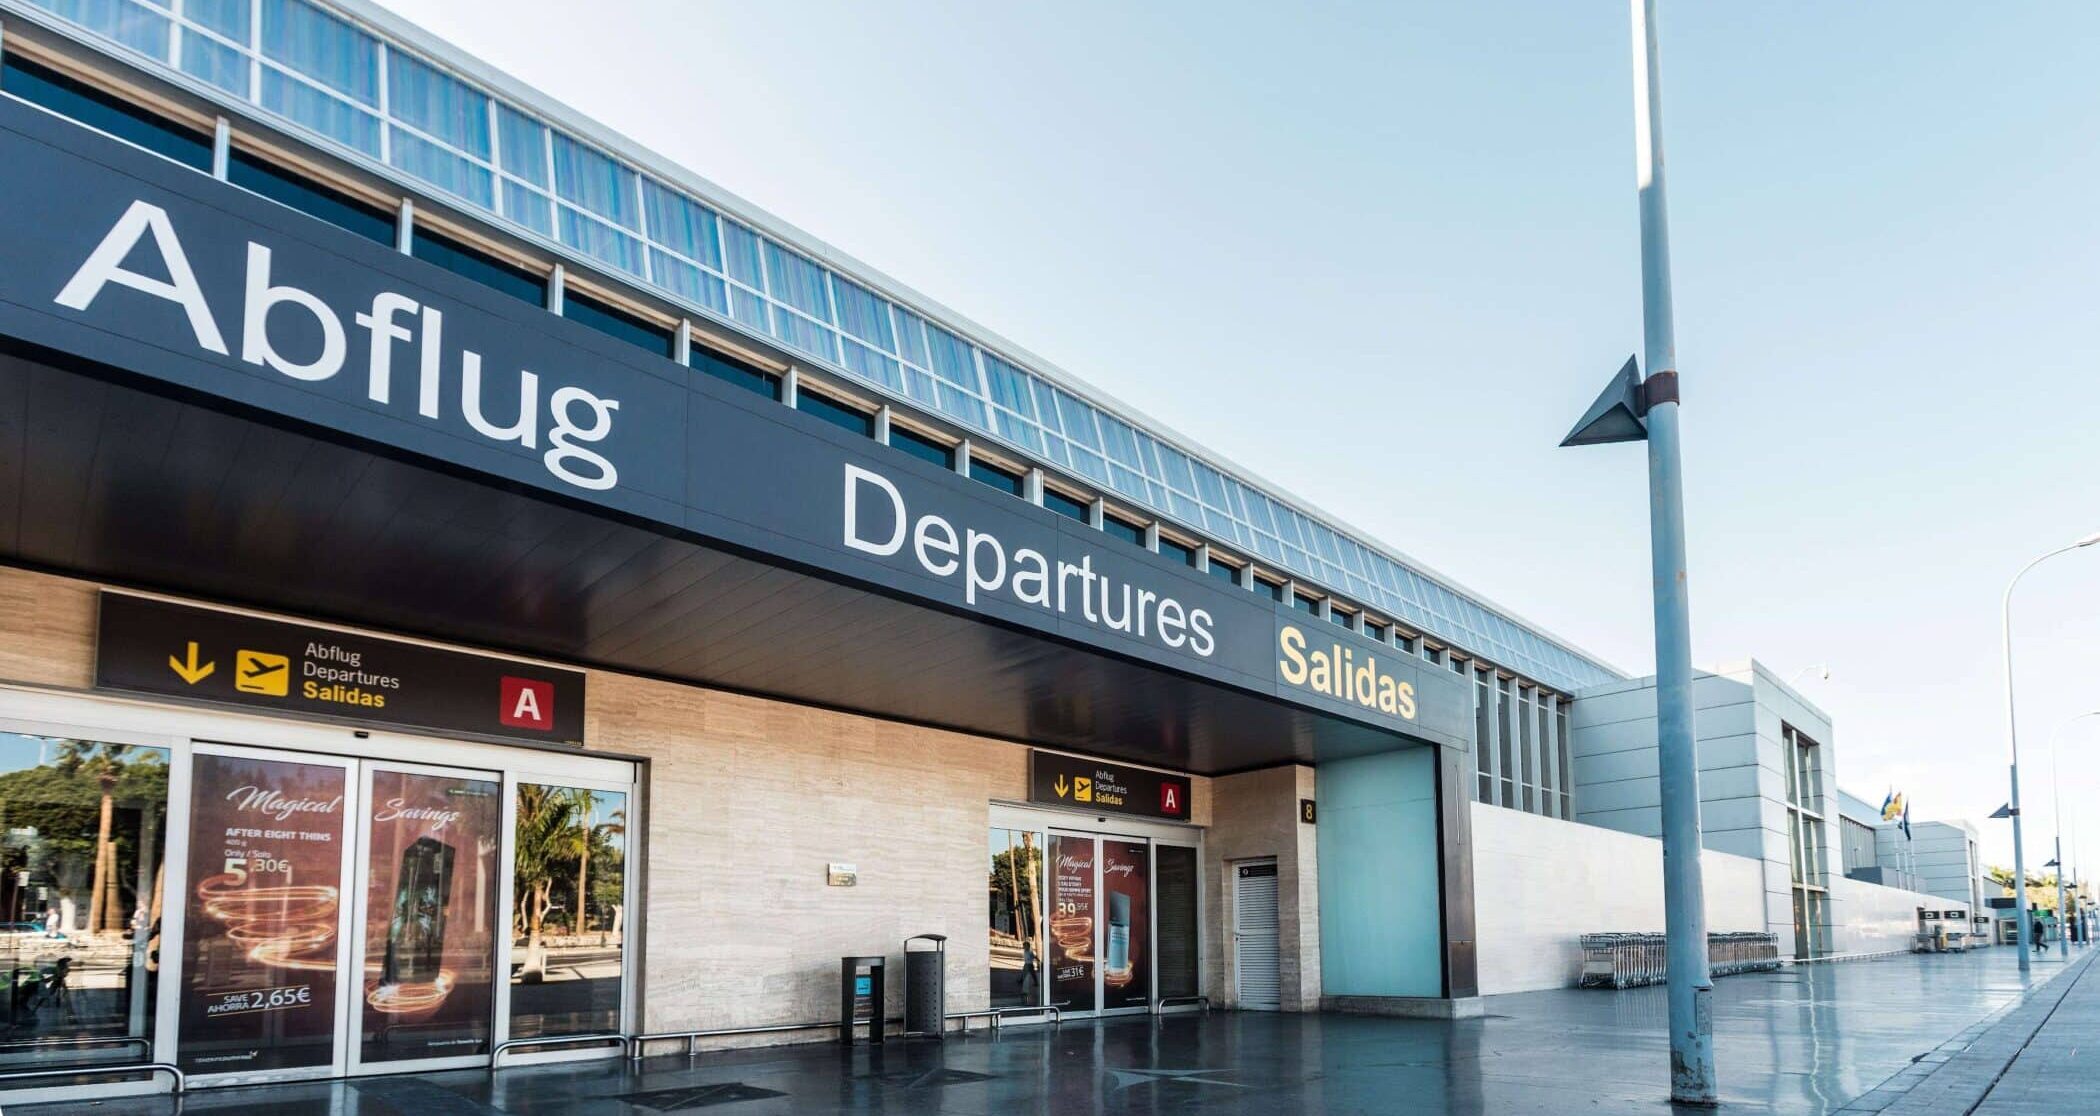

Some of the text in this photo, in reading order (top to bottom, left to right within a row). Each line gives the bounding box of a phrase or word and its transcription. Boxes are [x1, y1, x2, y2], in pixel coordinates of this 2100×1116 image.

[54, 199, 620, 491] Abflug
[843, 462, 1216, 658] Departures
[304, 642, 361, 667] Abflug
[303, 661, 400, 689] Departures
[1279, 626, 1417, 721] Salidas
[303, 681, 385, 708] Salidas
[513, 687, 542, 721] A
[1095, 769, 1114, 783] Abflug
[1095, 780, 1128, 795] Departures
[225, 785, 461, 831] Magical Savings
[1095, 792, 1123, 806] Salidas
[1165, 788, 1176, 808] A
[1305, 803, 1313, 820] 8
[225, 827, 331, 842] AFTER EIGHT THINS
[224, 849, 245, 859] Only
[207, 1002, 250, 1013] AHORRA
[223, 986, 311, 1010] SAVE 2,65€
